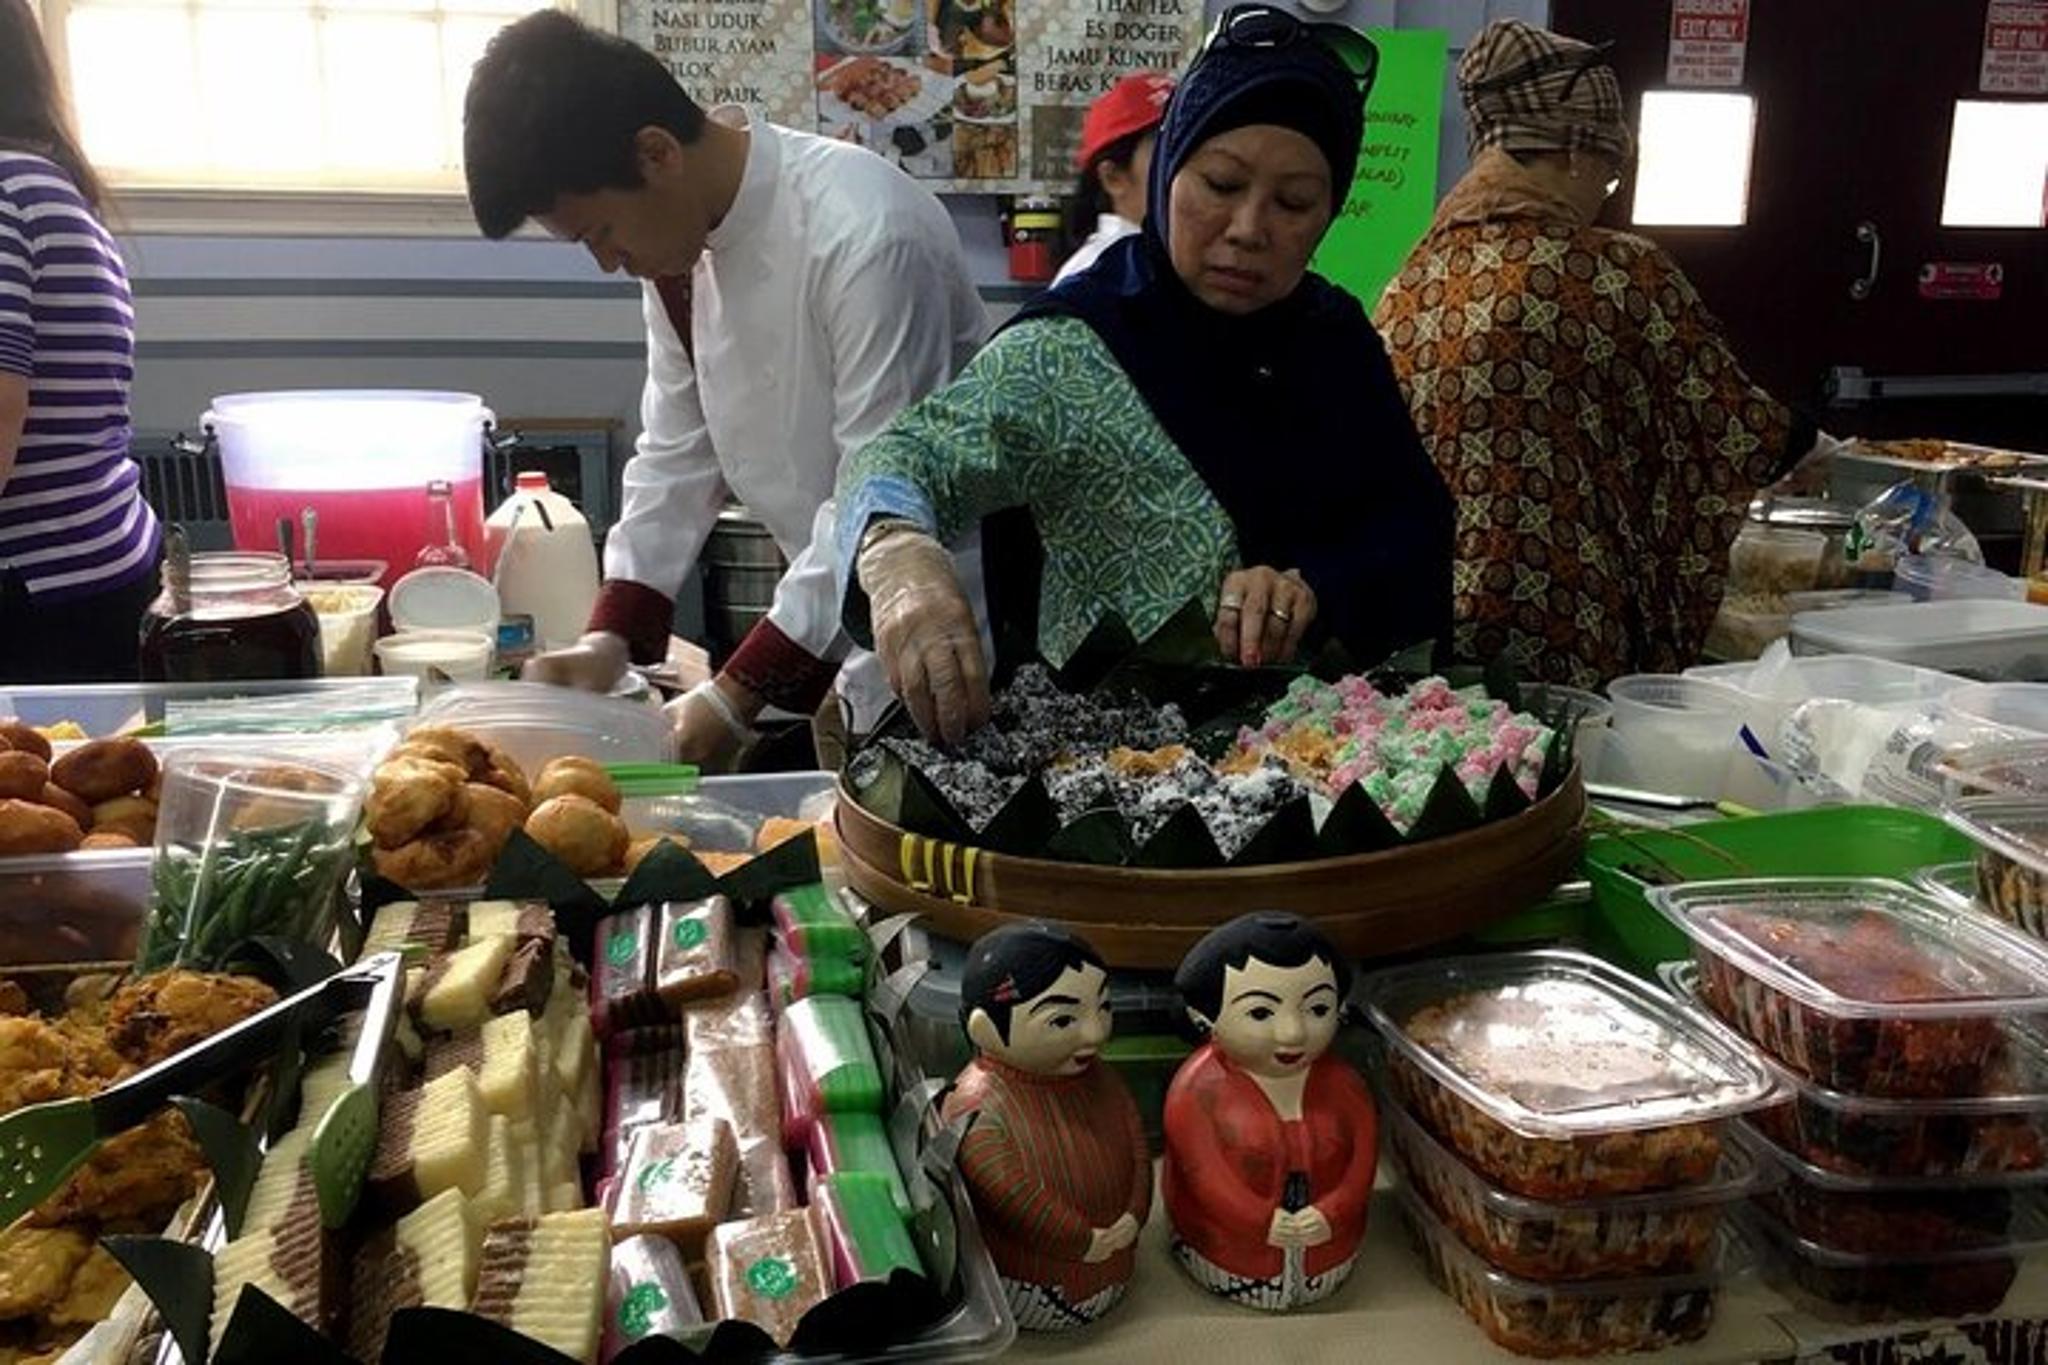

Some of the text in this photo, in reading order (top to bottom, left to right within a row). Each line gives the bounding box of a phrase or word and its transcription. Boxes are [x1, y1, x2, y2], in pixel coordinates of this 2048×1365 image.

[1148, 0, 1183, 15] TEA
[653, 9, 763, 30] NASI UDUK
[1680, 19, 1739, 38] EXIT ONLY
[1086, 20, 1182, 42] ES DOGER
[654, 34, 777, 54] BUBUR AYAM
[1046, 45, 1181, 69] JAMU KUNYIT
[1033, 71, 1093, 92] BERAS
[713, 87, 763, 103] PAUK
